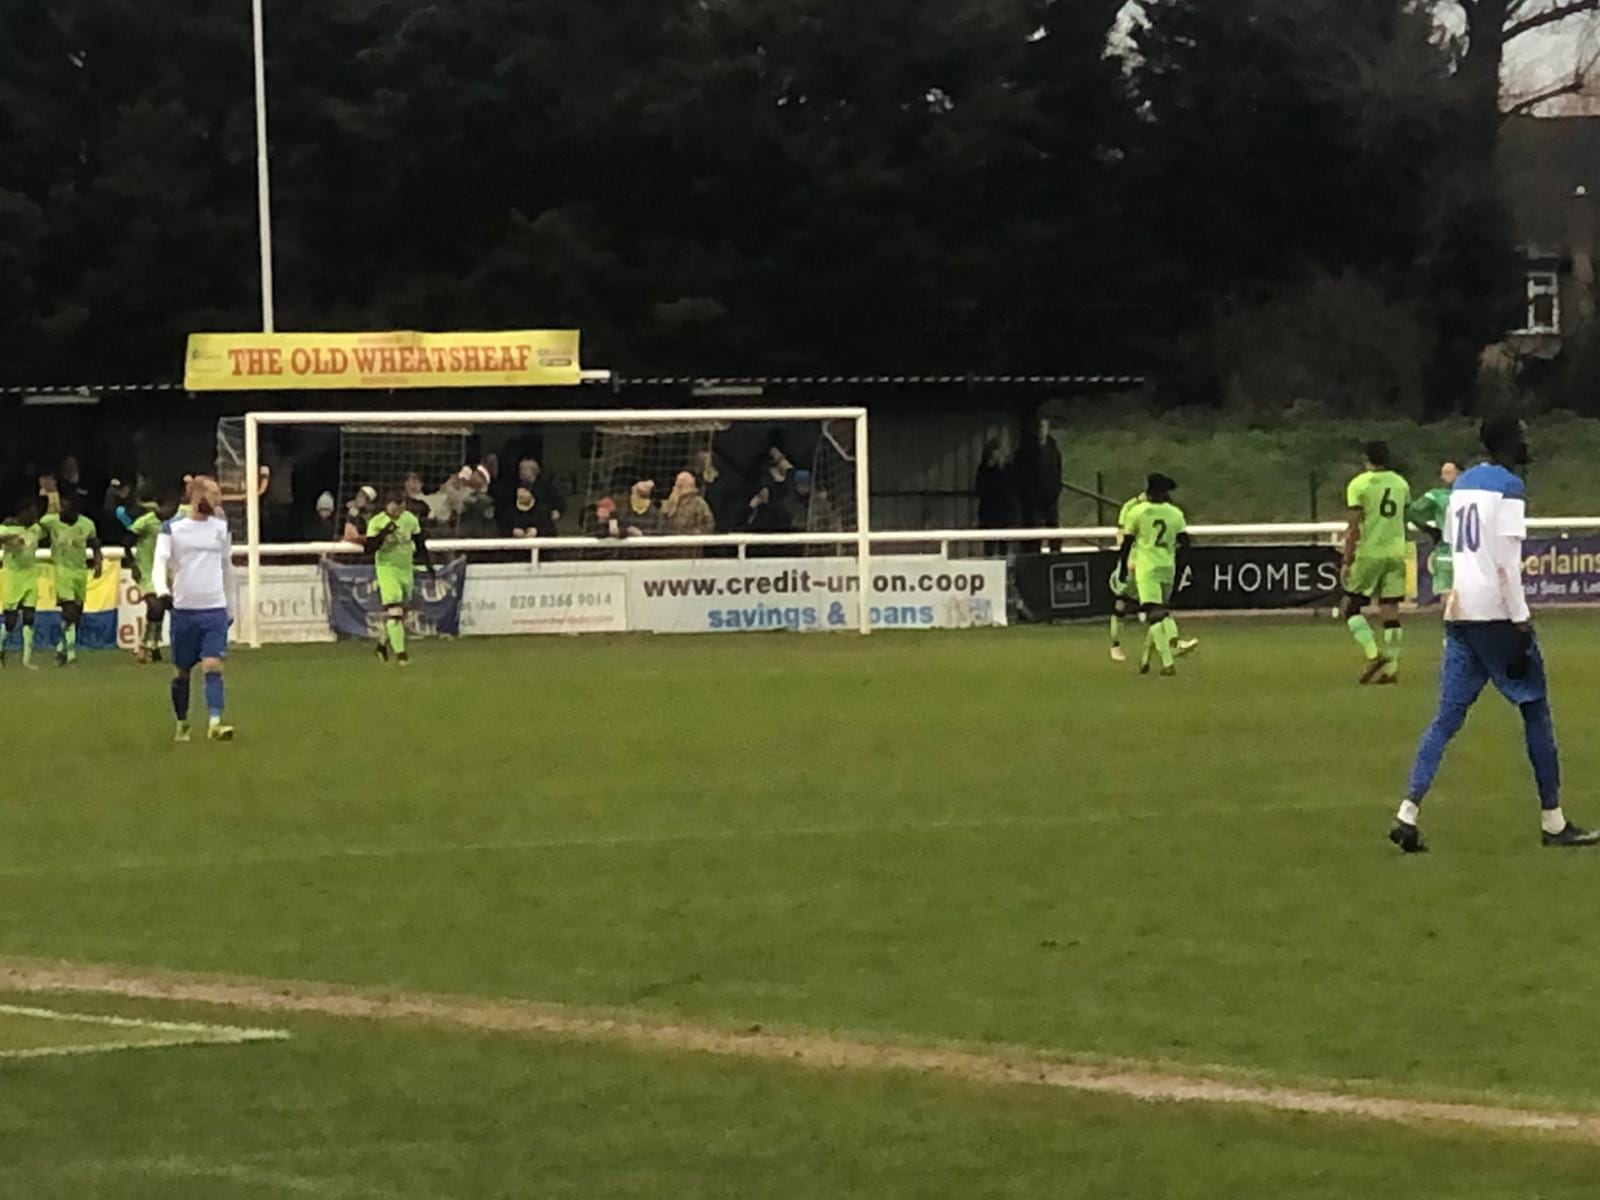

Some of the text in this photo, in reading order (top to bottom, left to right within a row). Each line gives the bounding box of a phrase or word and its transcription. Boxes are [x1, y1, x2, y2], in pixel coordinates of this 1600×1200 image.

[229, 348, 283, 375] THE
[290, 348, 349, 375] OLD
[351, 344, 532, 374] WHEATSHEAF
[1379, 486, 1397, 519] 6
[1151, 518, 1170, 549] 2
[1454, 502, 1481, 554] 10
[643, 567, 985, 598] www.credit-unon.coop
[1213, 561, 1338, 593] HOMES
[707, 600, 934, 629] savings & oans
